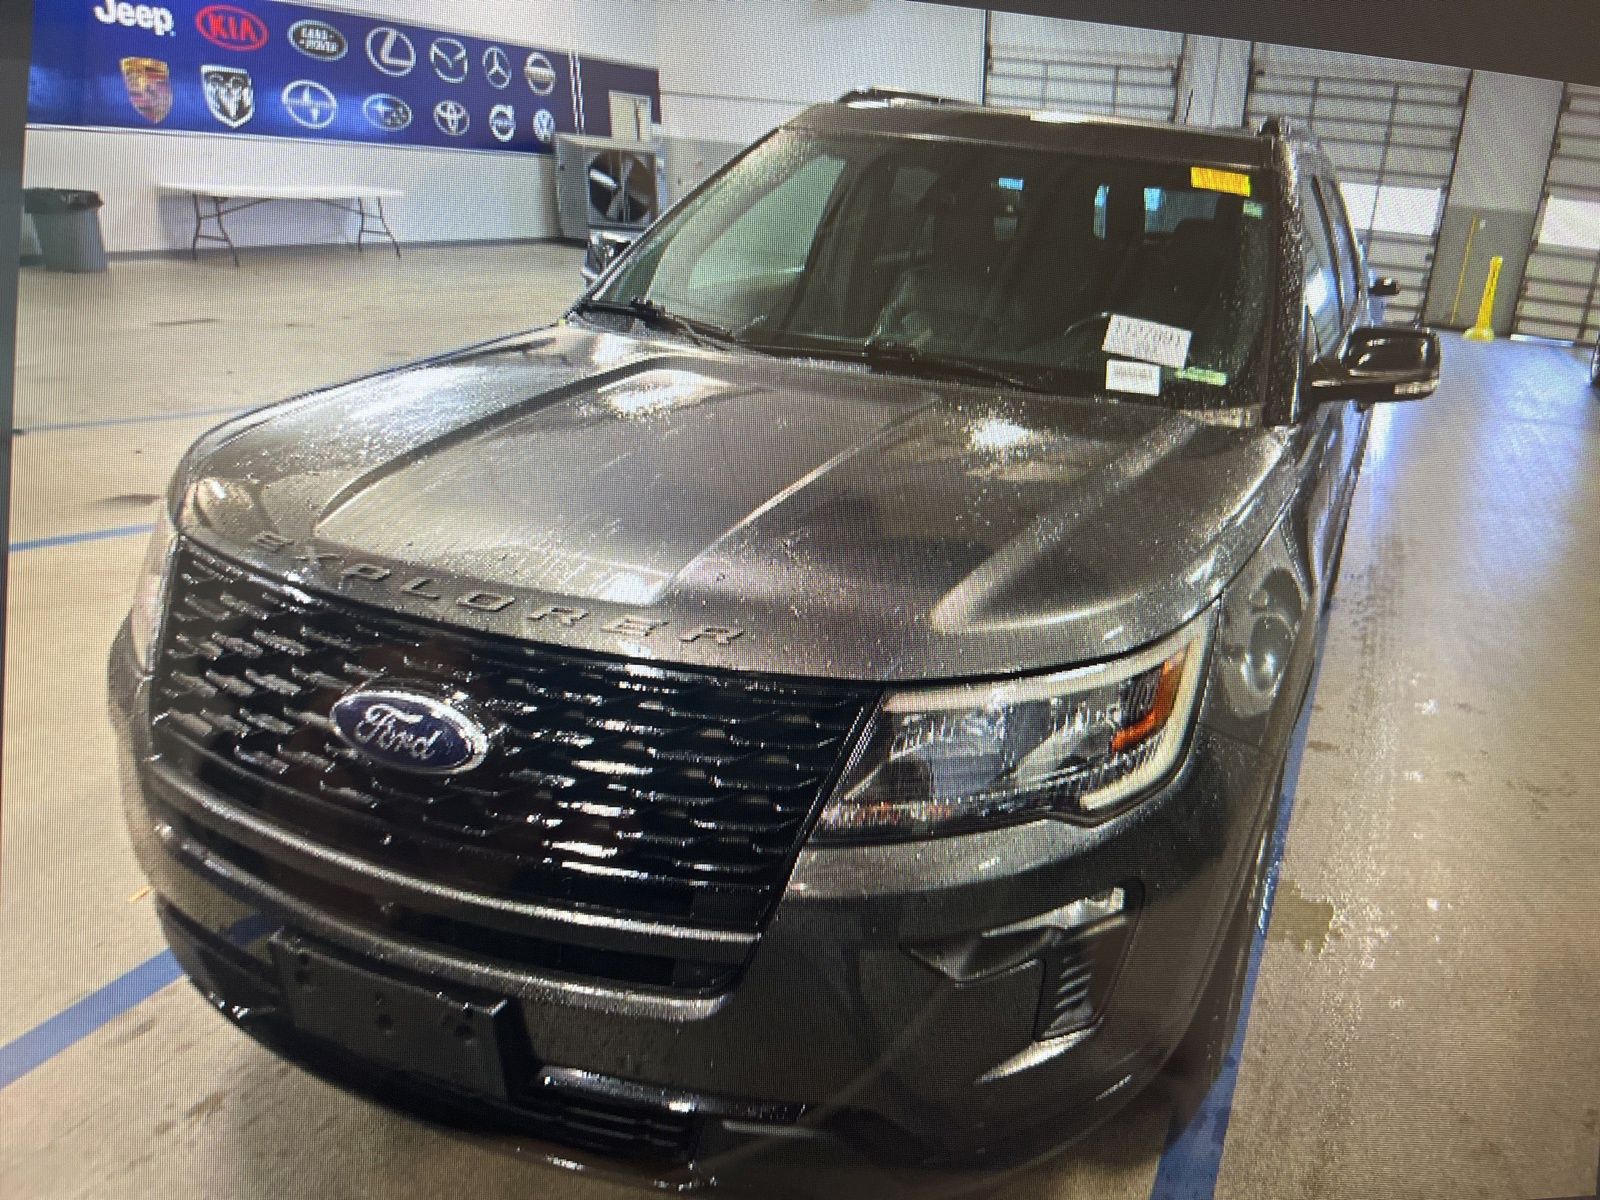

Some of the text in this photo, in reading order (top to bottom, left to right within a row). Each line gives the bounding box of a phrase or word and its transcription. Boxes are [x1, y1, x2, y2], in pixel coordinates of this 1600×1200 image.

[94, 0, 175, 36] Jeep
[208, 14, 258, 41] KIA
[249, 530, 744, 646] EXPLORER
[353, 703, 445, 761] Ford
